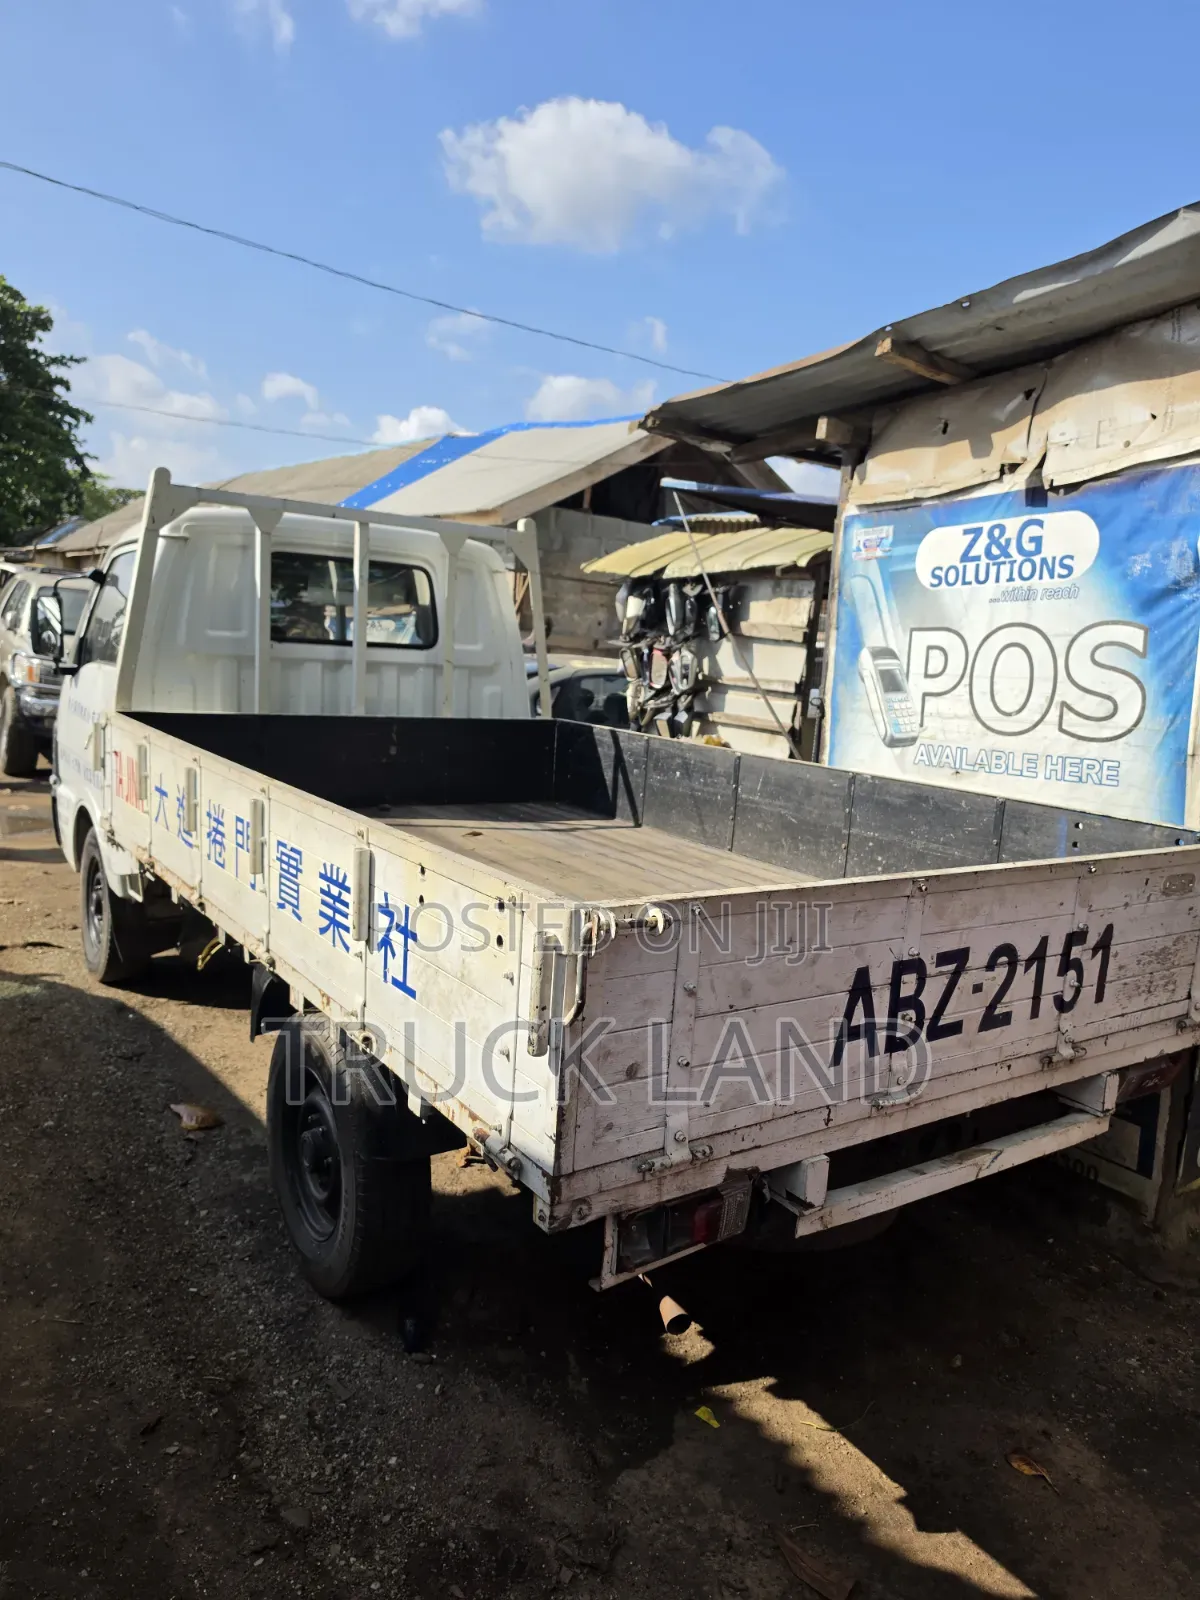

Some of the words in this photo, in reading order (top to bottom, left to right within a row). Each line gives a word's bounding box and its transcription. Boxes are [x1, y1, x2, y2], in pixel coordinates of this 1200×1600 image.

[959, 518, 1045, 563] Z&G
[929, 554, 1076, 589] SOLUTIONS
[1040, 583, 1080, 601] reach
[906, 620, 1150, 743] POS
[913, 743, 1039, 778] AVAILABLE
[1044, 755, 1121, 787] HERE
